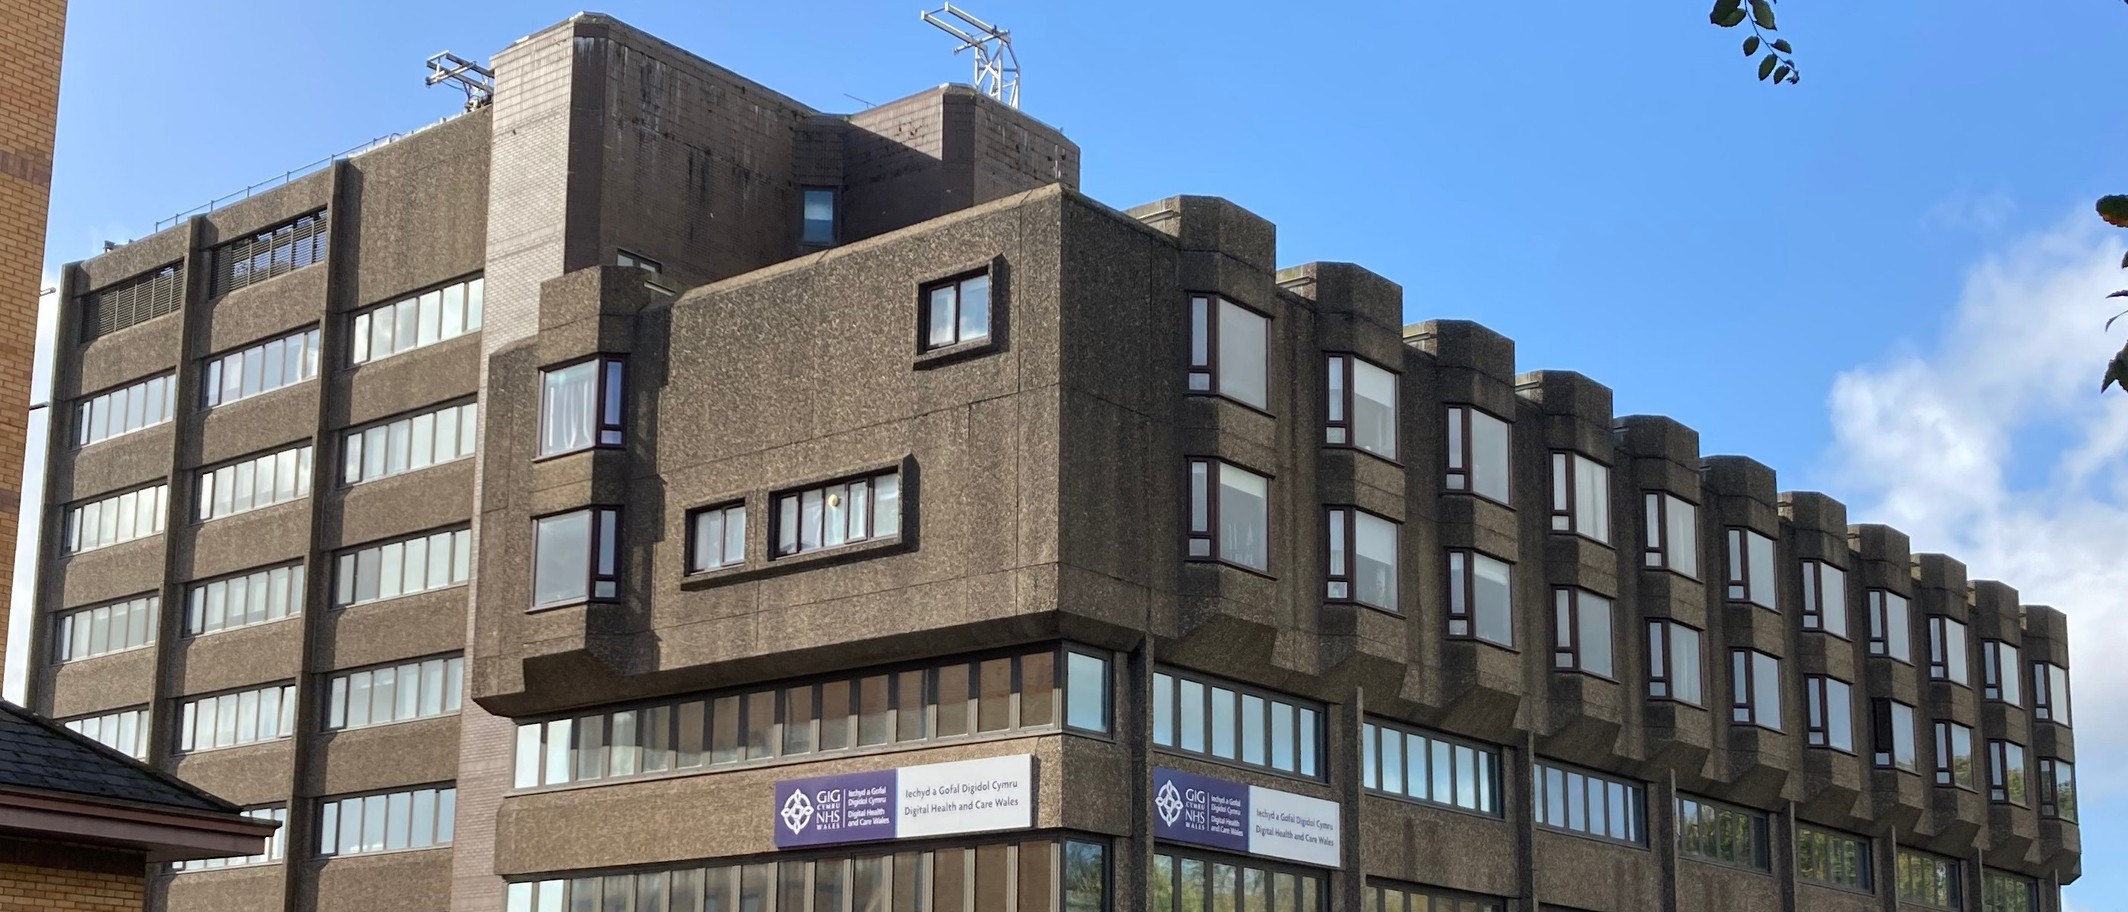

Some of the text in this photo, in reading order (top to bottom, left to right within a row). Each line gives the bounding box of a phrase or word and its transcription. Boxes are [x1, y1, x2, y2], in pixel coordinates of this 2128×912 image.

[817, 790, 840, 803] GIG
[871, 787, 886, 795] Gofal
[906, 787, 930, 799] Iechyd
[939, 784, 960, 795] Gofal
[962, 781, 990, 794] Digidol
[992, 780, 1018, 791] Cymru
[1186, 789, 1205, 803] GIG
[848, 798, 867, 807] Digidol
[905, 796, 1018, 817] Digital Health and Care Wales
[1186, 802, 1205, 810] CYMRU
[816, 810, 840, 824] NHS
[848, 810, 866, 819] Digital
[1185, 809, 1205, 824] NHS
[1256, 809, 1274, 820] Iechyd
[1280, 813, 1295, 823] Gofal
[1296, 816, 1315, 827] Digidol
[1316, 820, 1333, 830] Cymru
[1186, 822, 1205, 830] WALES
[1256, 825, 1333, 846] Digital Health and Care Wales
